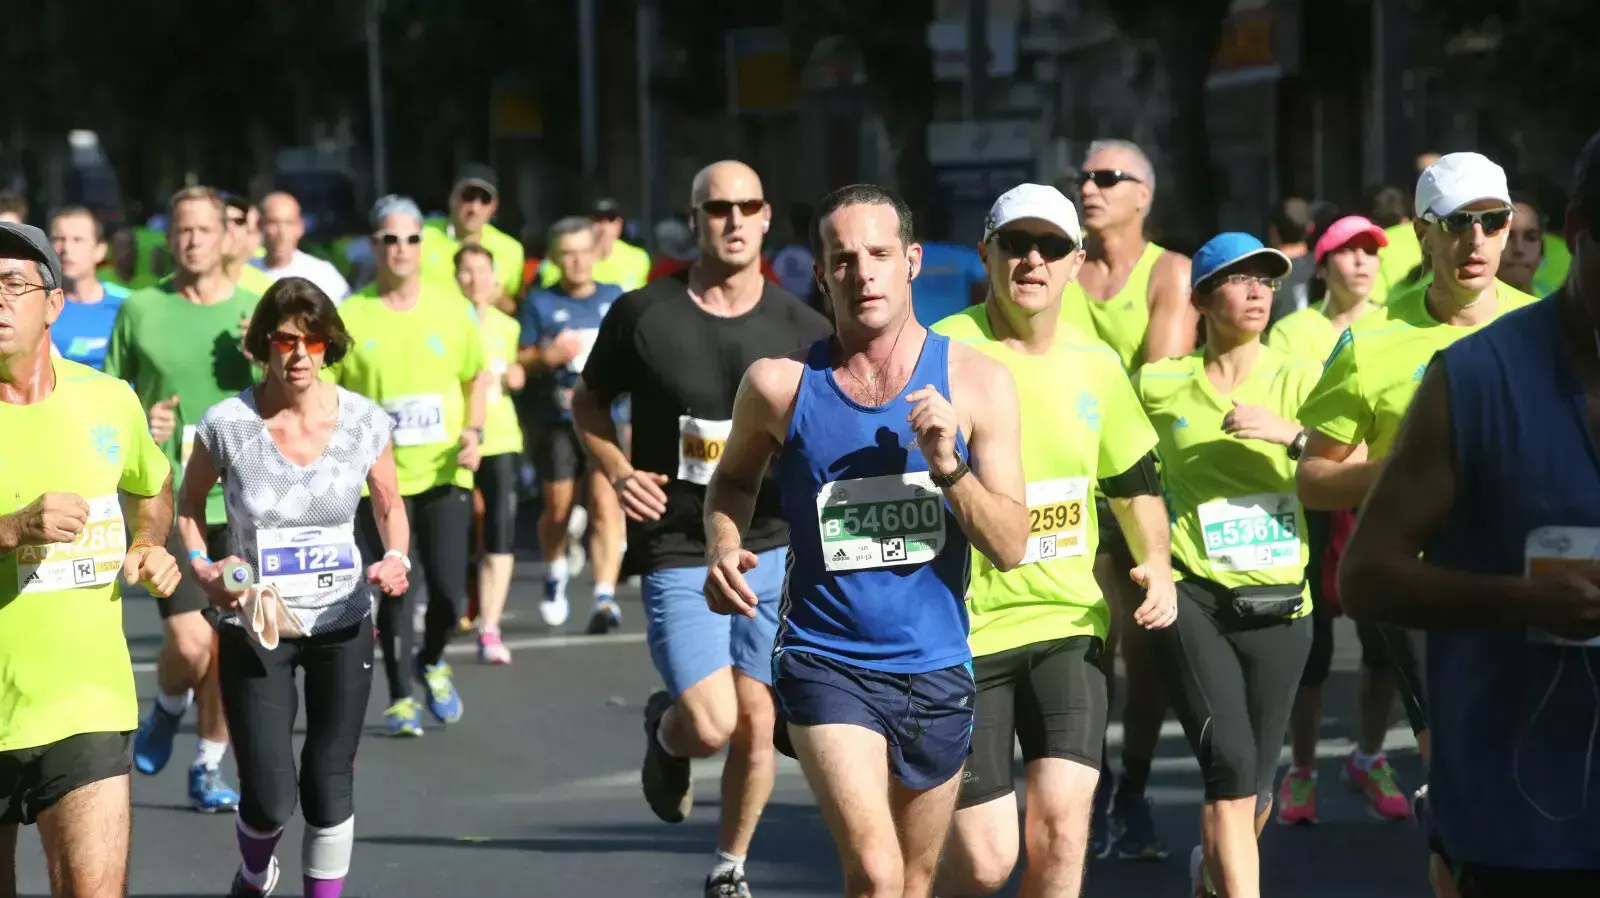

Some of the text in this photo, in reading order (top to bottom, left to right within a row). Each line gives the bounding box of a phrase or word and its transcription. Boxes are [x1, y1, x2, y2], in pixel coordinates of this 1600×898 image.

[825, 500, 938, 536] B54600
[1028, 502, 1080, 532] 2593
[1208, 514, 1296, 546] B53615
[266, 545, 340, 571] B 122
